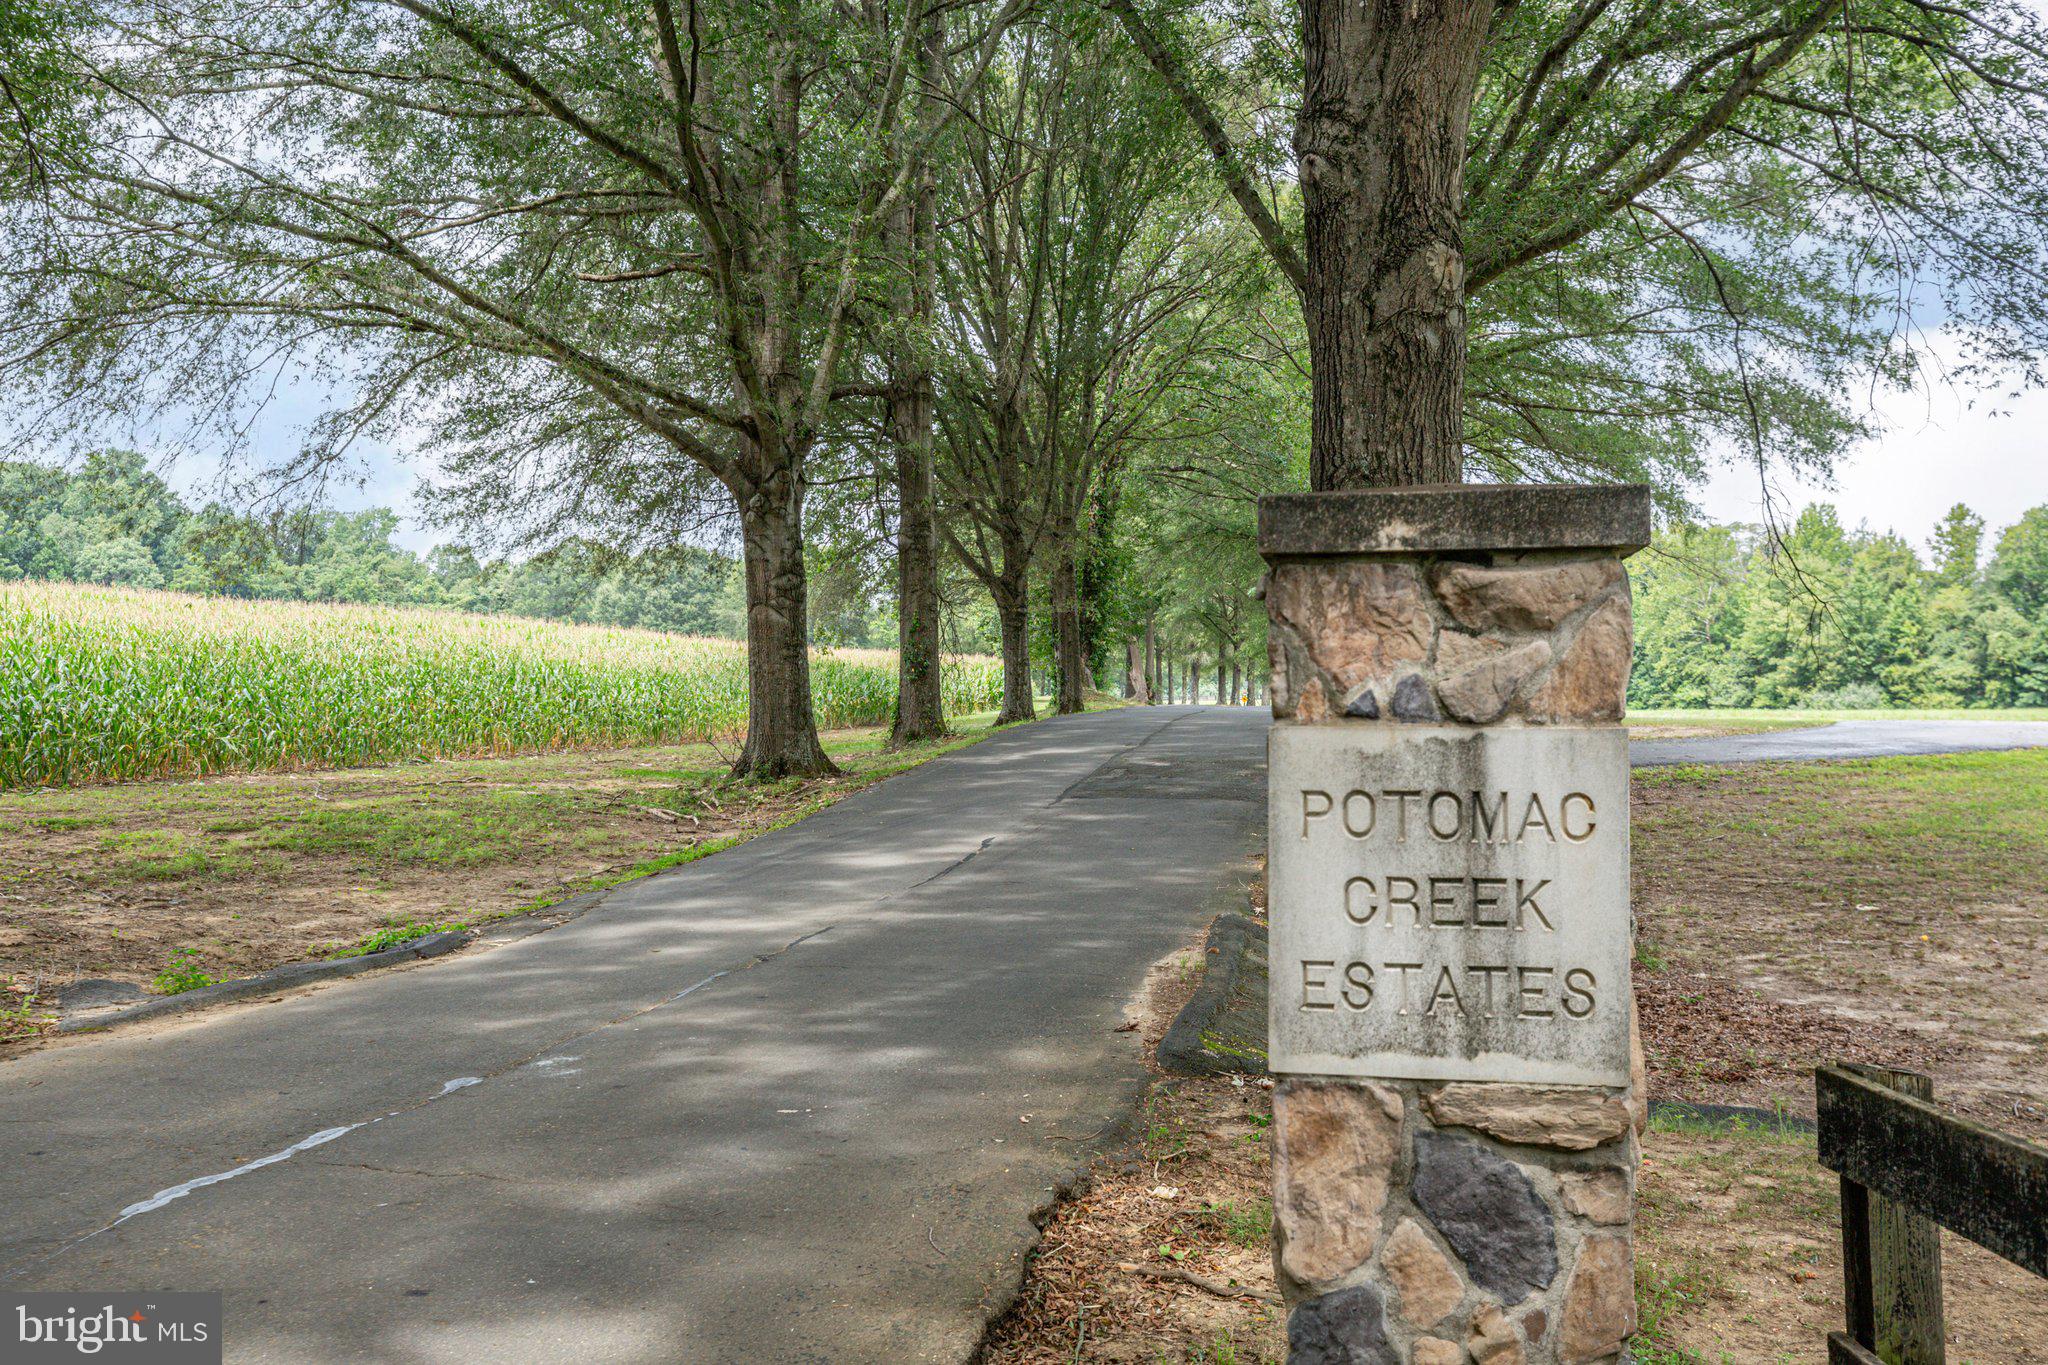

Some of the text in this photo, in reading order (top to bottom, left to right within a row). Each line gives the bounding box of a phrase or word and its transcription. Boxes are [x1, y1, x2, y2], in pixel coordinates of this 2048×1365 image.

[1300, 789, 1597, 844] POTOMAC
[1343, 875, 1555, 932] CREEK
[1300, 959, 1597, 1021] ESTATES
